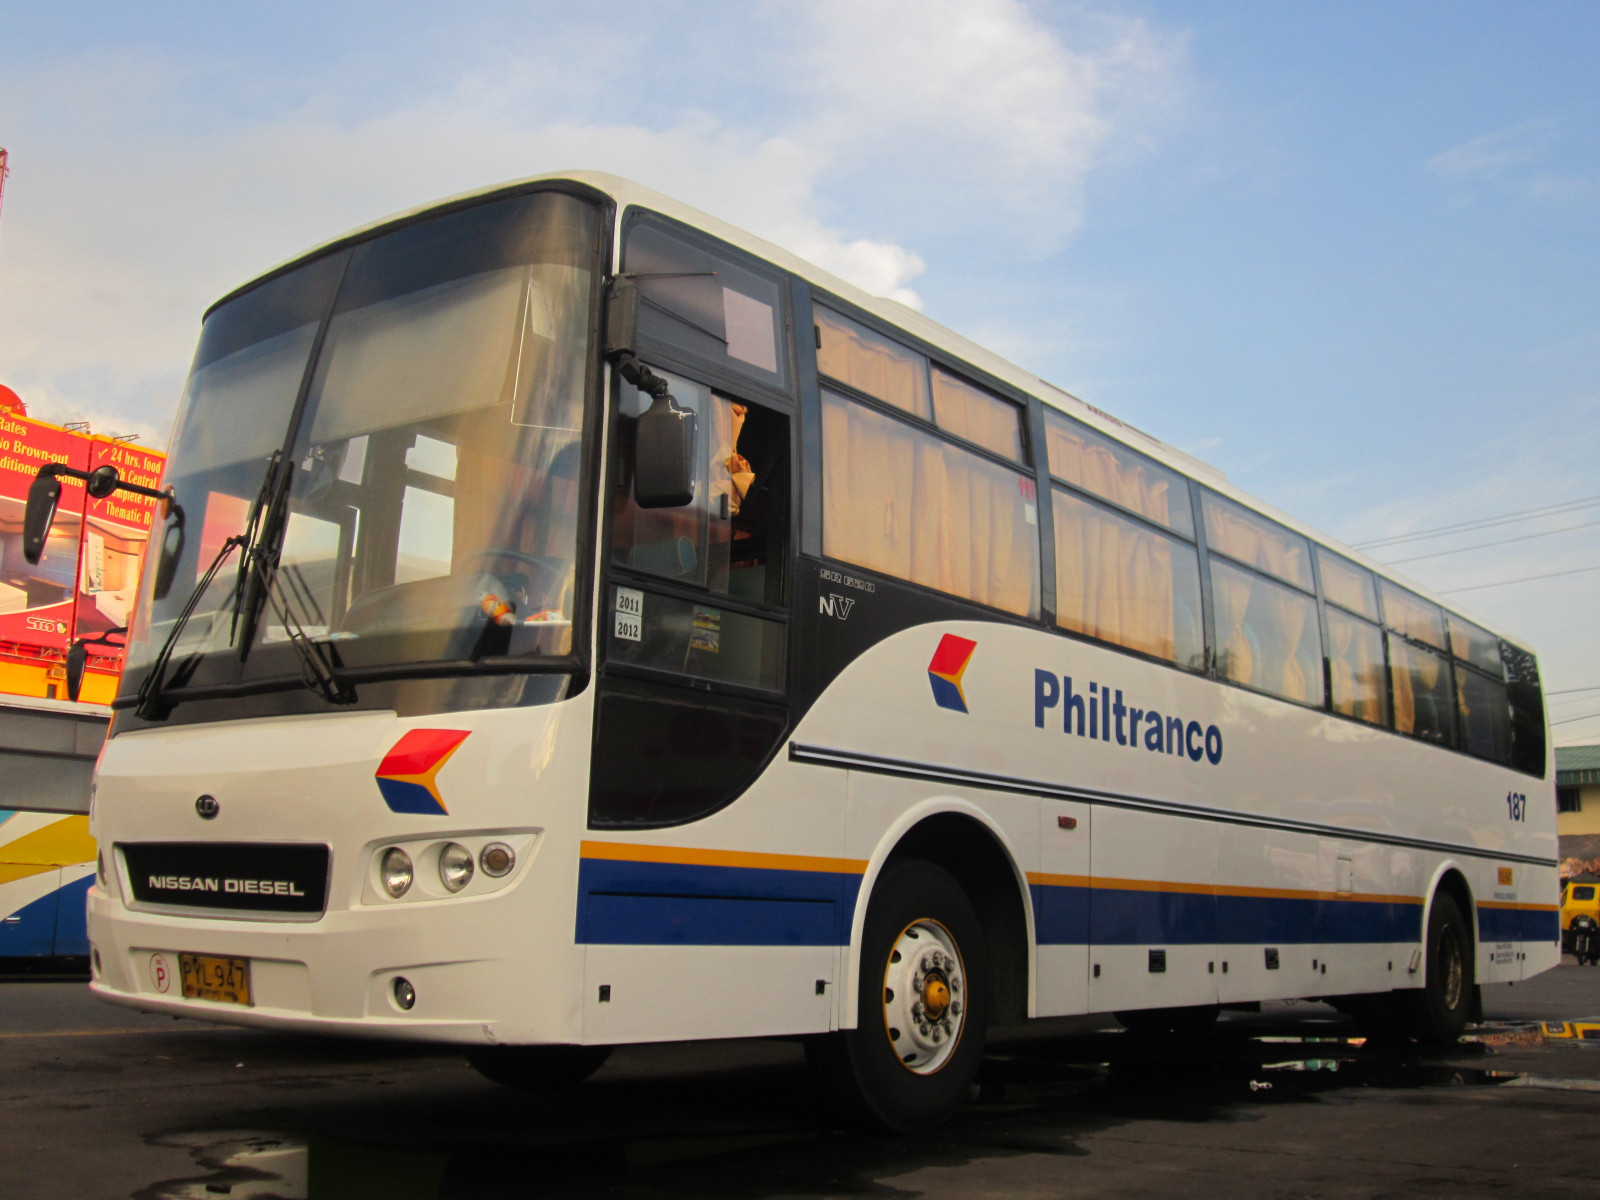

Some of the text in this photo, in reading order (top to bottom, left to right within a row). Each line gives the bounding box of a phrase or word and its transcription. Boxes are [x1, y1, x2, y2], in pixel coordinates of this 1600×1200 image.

[13, 440, 69, 465] Brown-out
[110, 447, 162, 474] 24 hrs. food
[0, 456, 41, 477] ditione
[127, 470, 157, 490] Central
[106, 500, 142, 524] Thematic
[619, 595, 639, 613] 2011
[819, 593, 855, 621] NV
[618, 622, 638, 638] 2012
[1034, 668, 1223, 766] Philtranco
[1506, 791, 1526, 822] 187
[148, 875, 305, 897] NISSAN DIESEL
[215, 964, 245, 990] 947
